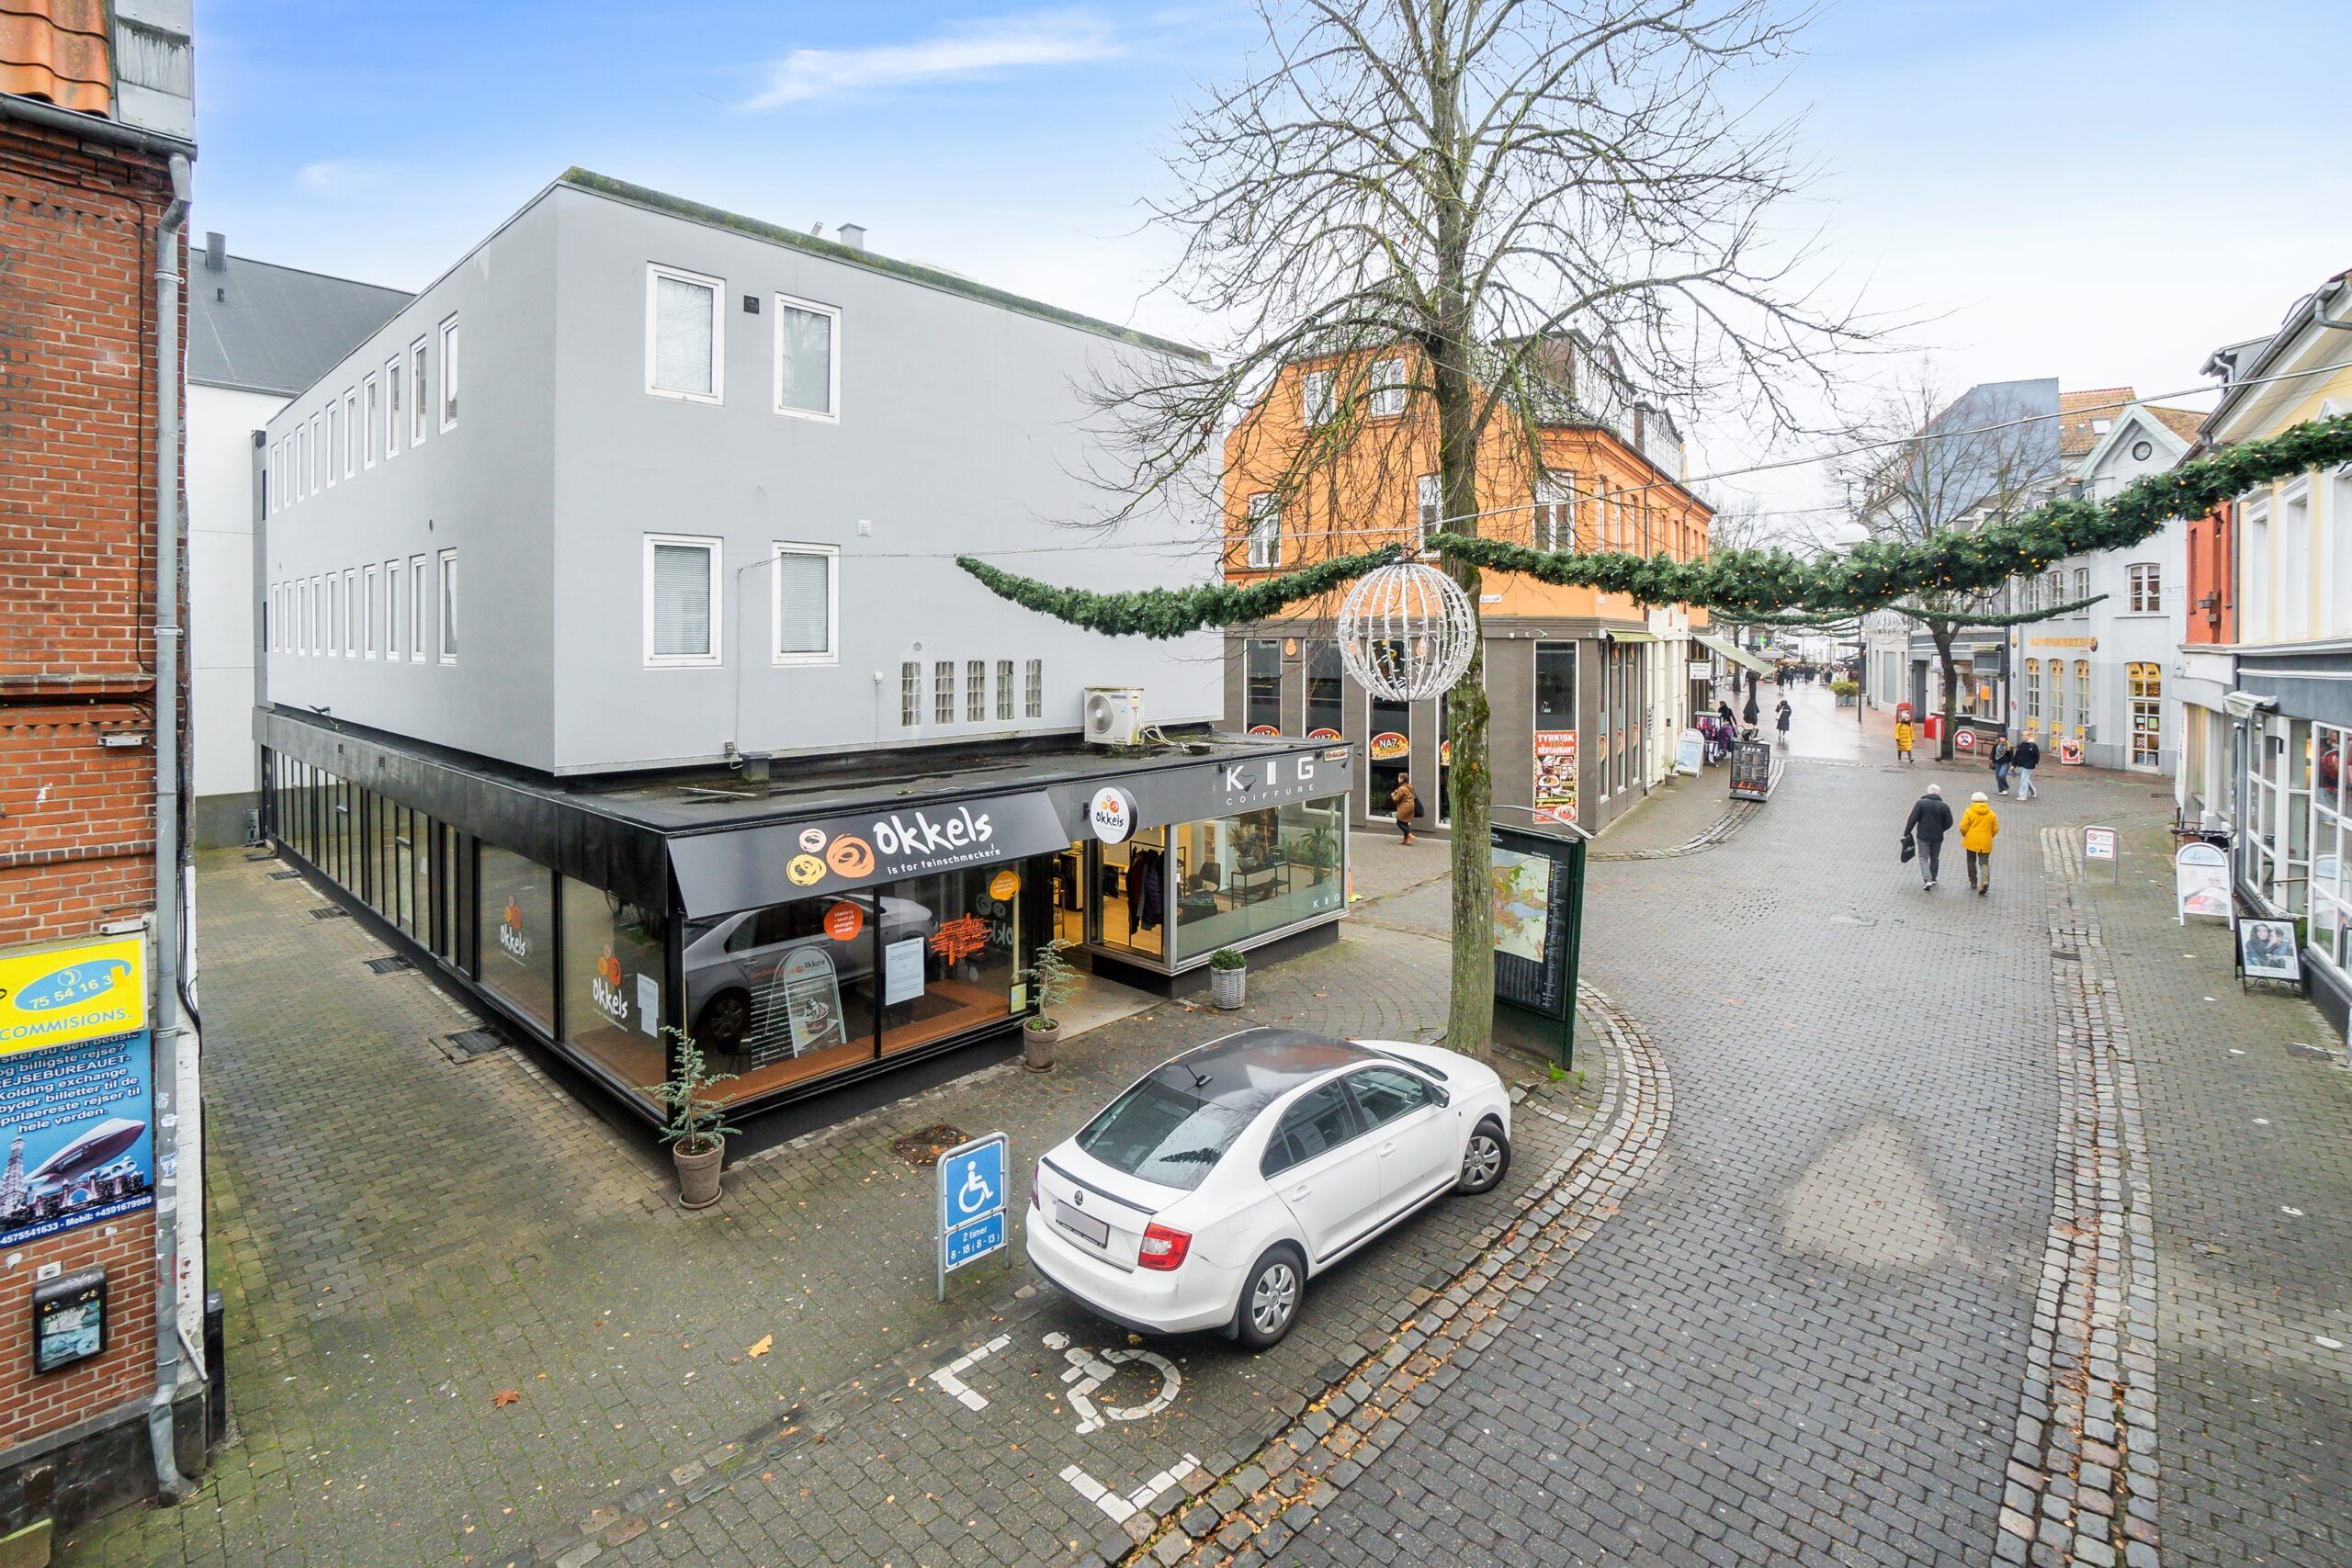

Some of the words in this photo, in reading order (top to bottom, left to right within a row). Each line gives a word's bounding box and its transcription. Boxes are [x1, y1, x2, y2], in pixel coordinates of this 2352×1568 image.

[1537, 734, 1574, 742] TYRKISK
[1227, 784, 1314, 806] COIFFURE
[888, 866, 899, 874] is
[900, 863, 919, 873] for
[29, 996, 50, 1010] 75
[53, 987, 74, 1001] 54
[79, 979, 98, 993] 16
[0, 1008, 132, 1040] COMMISIONS.
[19, 1055, 77, 1076] billigste
[83, 1043, 125, 1060] rejse?
[59, 1067, 127, 1088] exchange
[46, 1084, 100, 1102] billetter
[105, 1078, 118, 1089] til
[121, 1077, 138, 1086] de
[84, 1091, 123, 1106] rejser
[128, 1087, 140, 1097] til
[18, 1119, 50, 1134] hele
[54, 1108, 108, 1124] verden.
[66, 1213, 94, 1227] Mobil:
[963, 1233, 968, 1242] 2
[969, 1225, 988, 1238] timer
[951, 1250, 956, 1259] 8
[963, 1244, 970, 1255] 18
[977, 1239, 981, 1248] 8
[989, 1234, 995, 1244] 13
